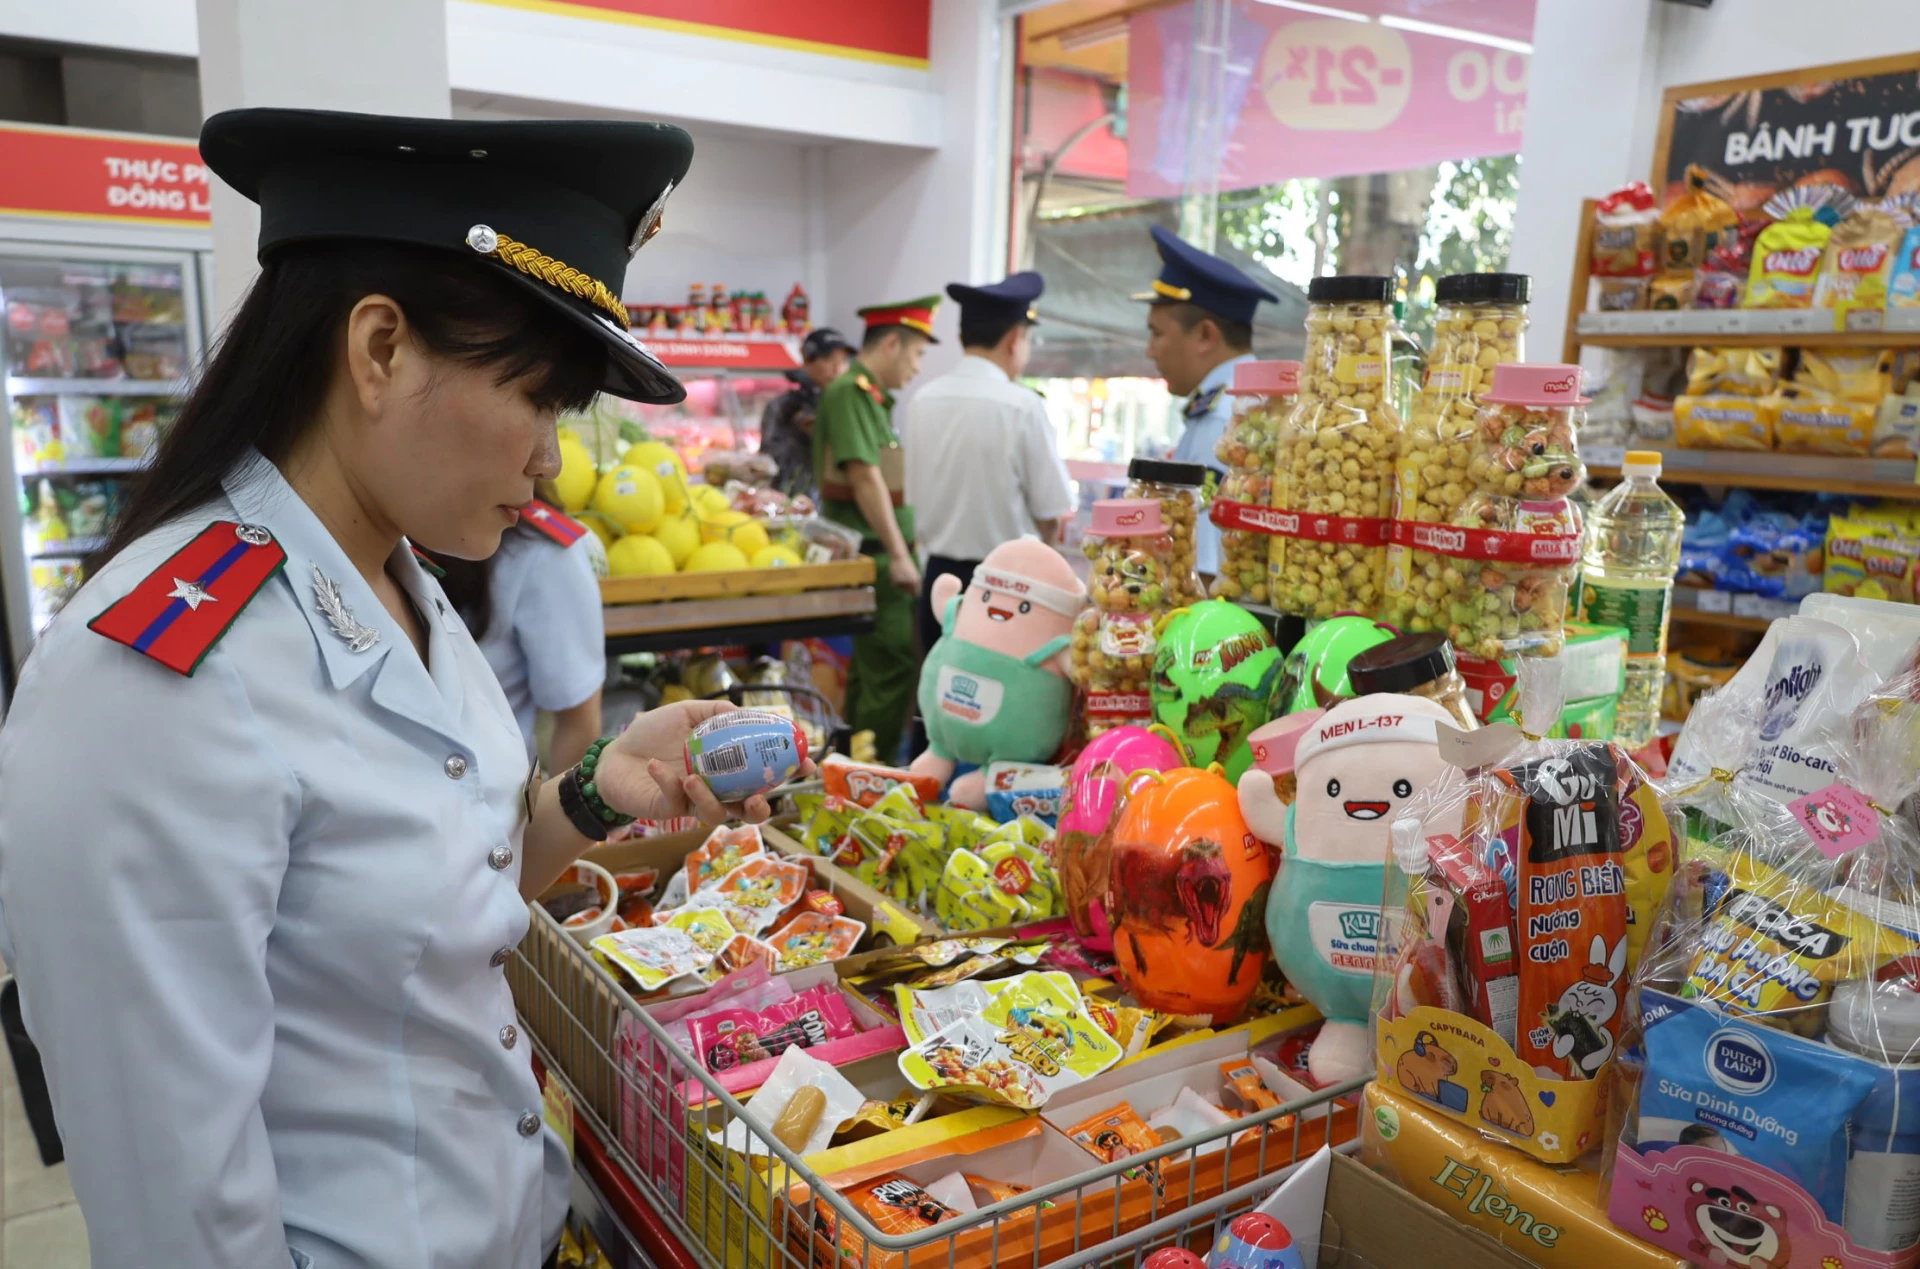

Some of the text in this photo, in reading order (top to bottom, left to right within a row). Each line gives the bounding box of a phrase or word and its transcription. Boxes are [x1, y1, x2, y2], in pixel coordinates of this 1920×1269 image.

[104, 157, 179, 186] THỰC
[107, 182, 212, 212] ĐÔNG L
[1320, 715, 1404, 742] MEN L-137
[1778, 745, 1835, 773] Bio-care
[1529, 870, 1577, 905] RONG
[1529, 911, 1580, 938] Nướng
[1729, 893, 1830, 956] POCA
[1351, 941, 1375, 953] chua
[1529, 938, 1568, 964] cuộn
[1429, 1021, 1486, 1049] CAPYBARA
[1720, 1045, 1763, 1069] DUTCH
[1723, 1055, 1757, 1077] LADY
[1658, 1079, 1799, 1146] Sữa Dinh Dưỡng
[1699, 1110, 1727, 1127] không
[1430, 1156, 1560, 1248] Elène
